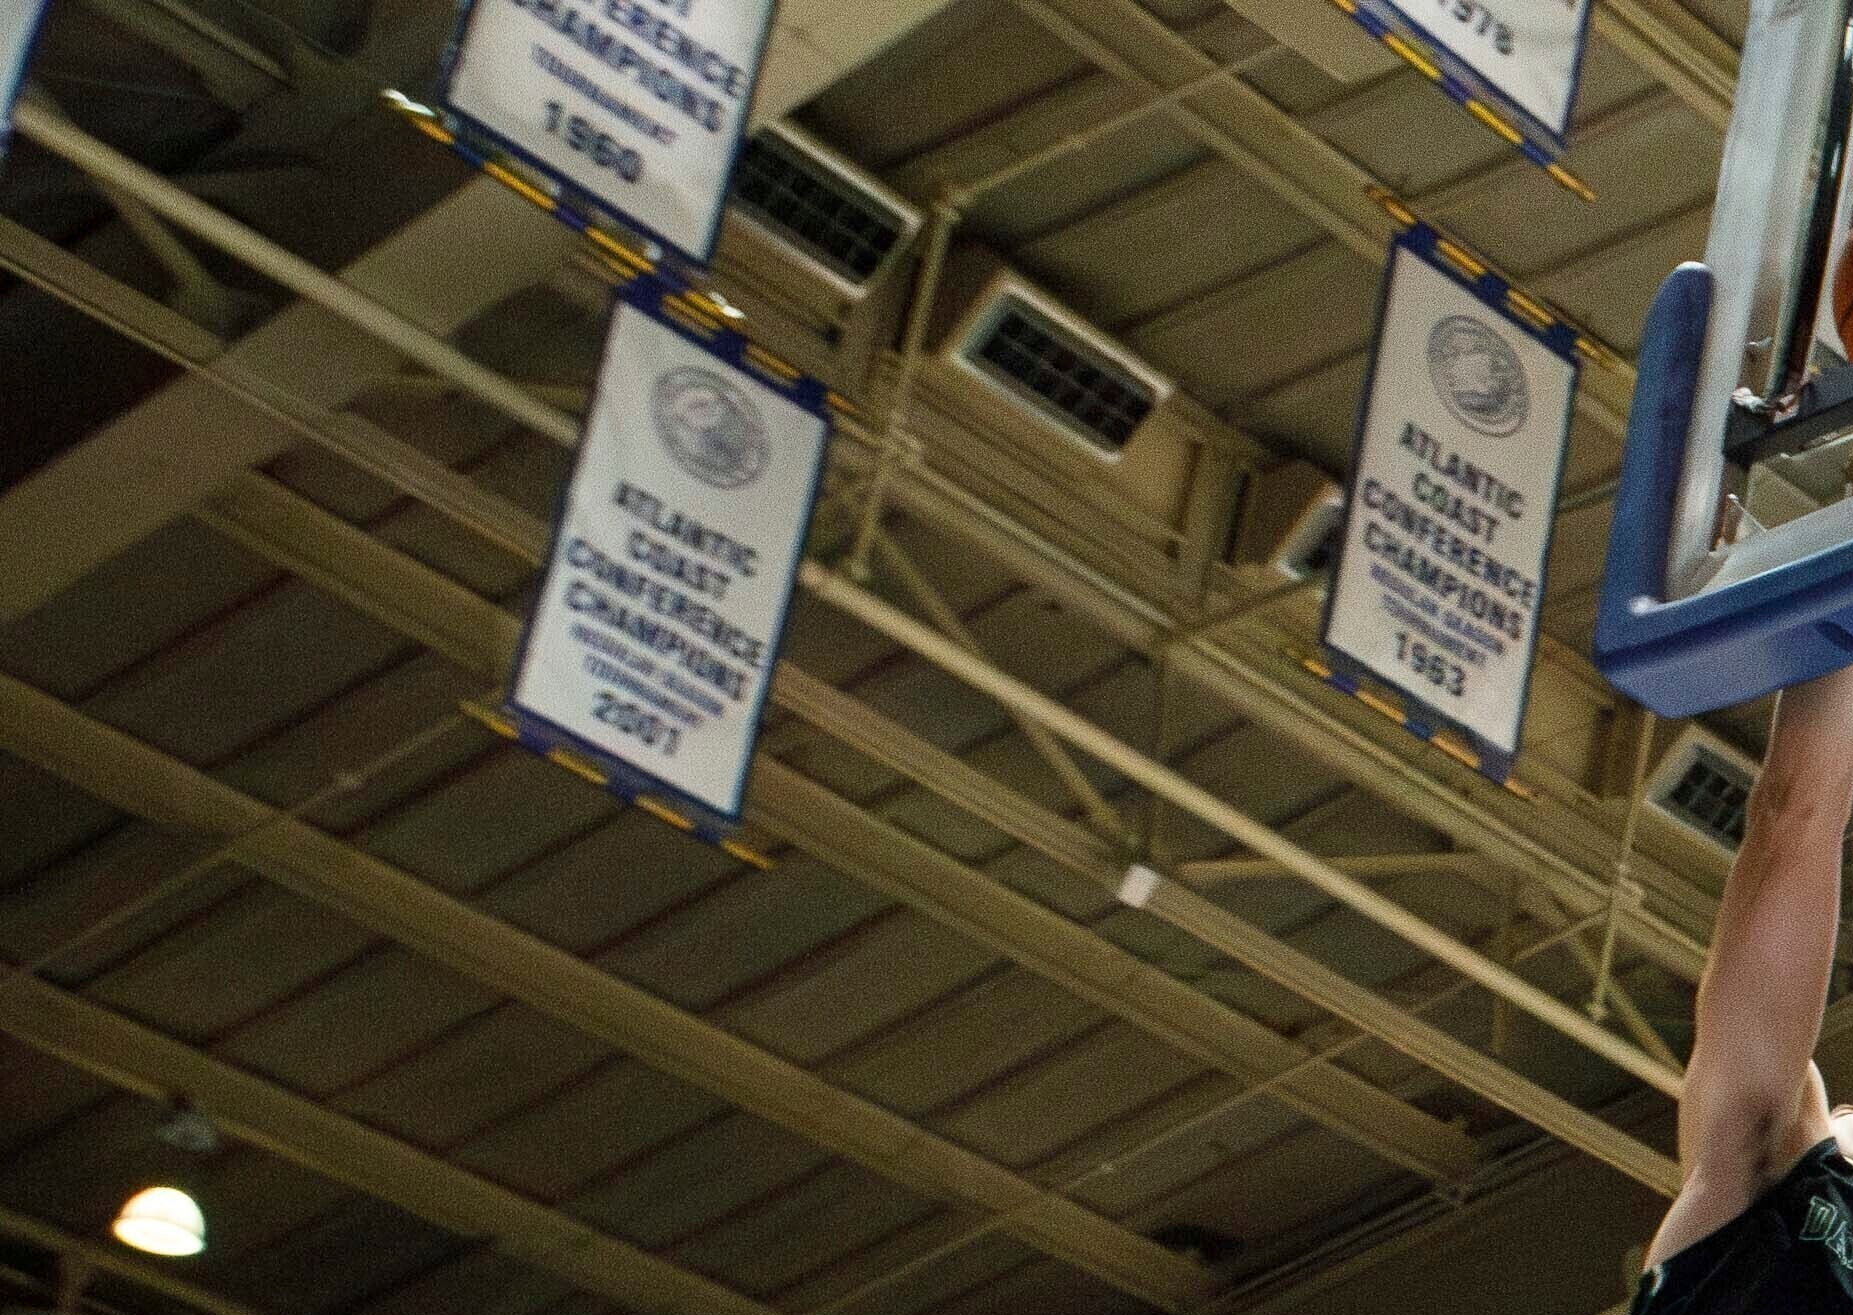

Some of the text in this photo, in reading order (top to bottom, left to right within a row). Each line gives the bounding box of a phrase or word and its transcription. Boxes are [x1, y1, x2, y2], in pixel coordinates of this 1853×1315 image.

[1400, 420, 1523, 520] ATLANTIC
[1413, 472, 1500, 543] COAST
[1363, 521, 1523, 640] CHAMPIONS
[1364, 478, 1536, 605] CONFERENCE
